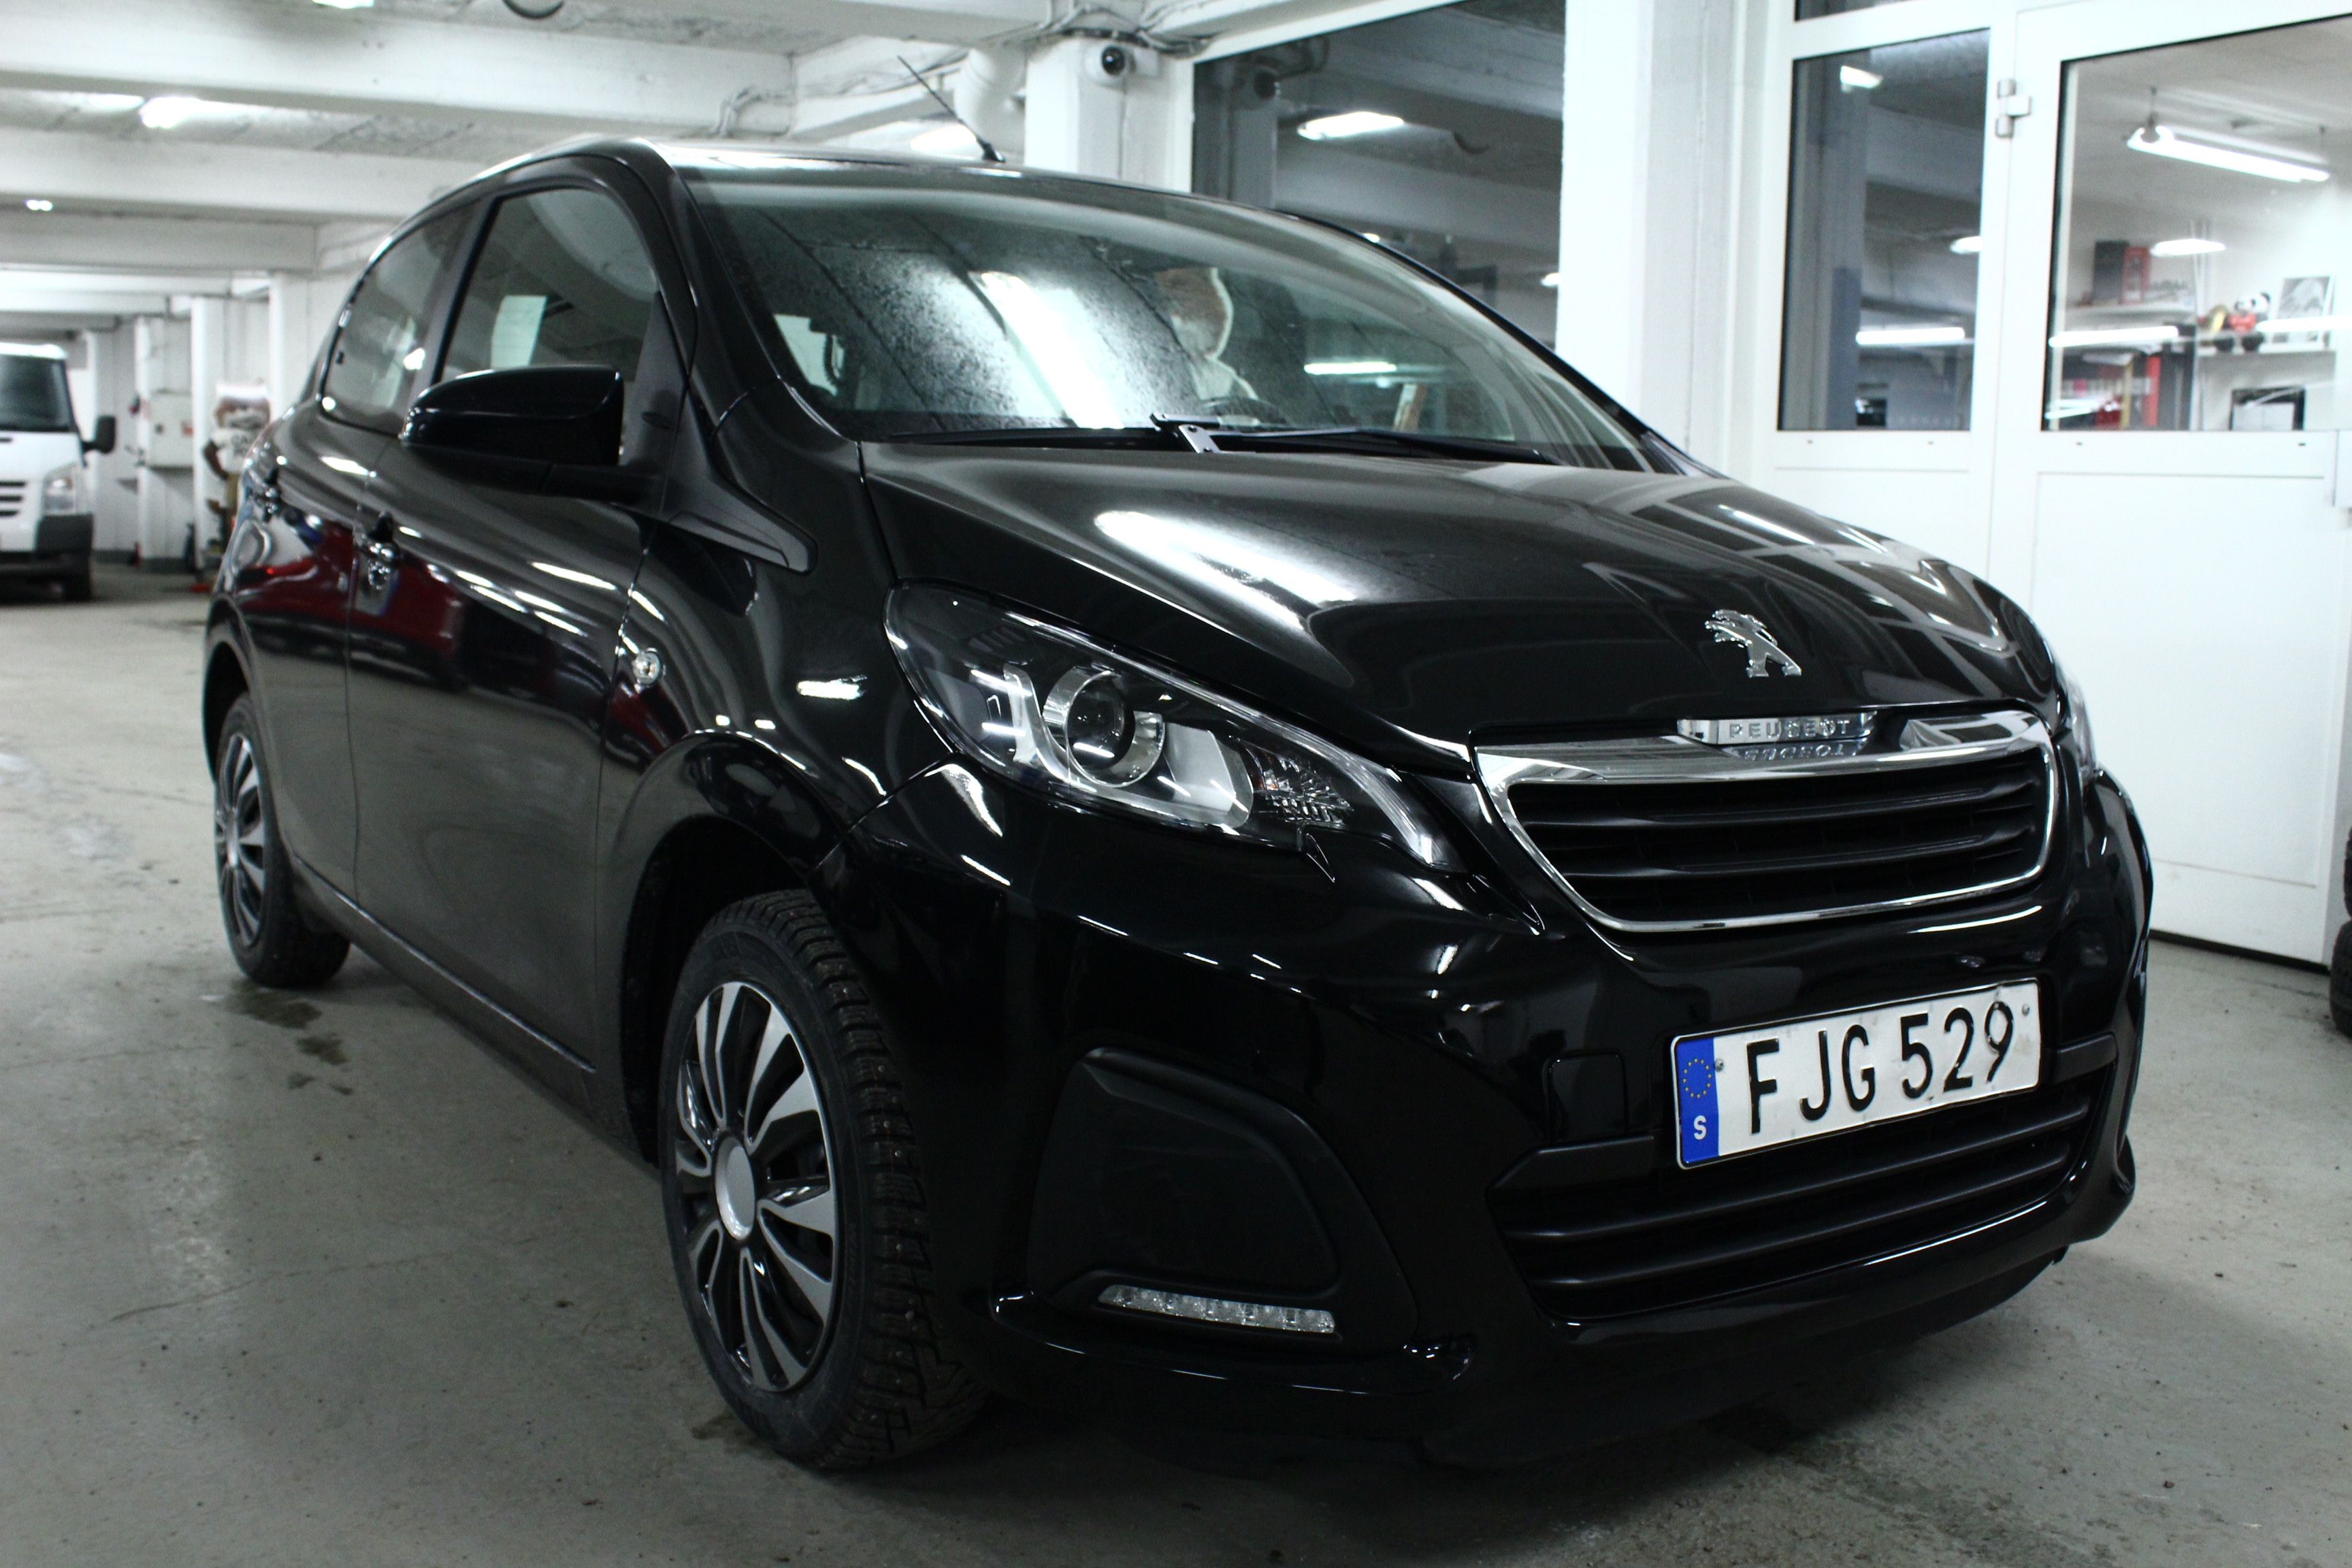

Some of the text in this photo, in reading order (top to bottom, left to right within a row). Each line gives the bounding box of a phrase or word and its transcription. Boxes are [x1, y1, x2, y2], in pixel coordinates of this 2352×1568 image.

[1729, 719, 1850, 739] PEUGEOT
[1746, 1000, 2014, 1134] FJG 529
[1693, 1115, 1708, 1141] S
